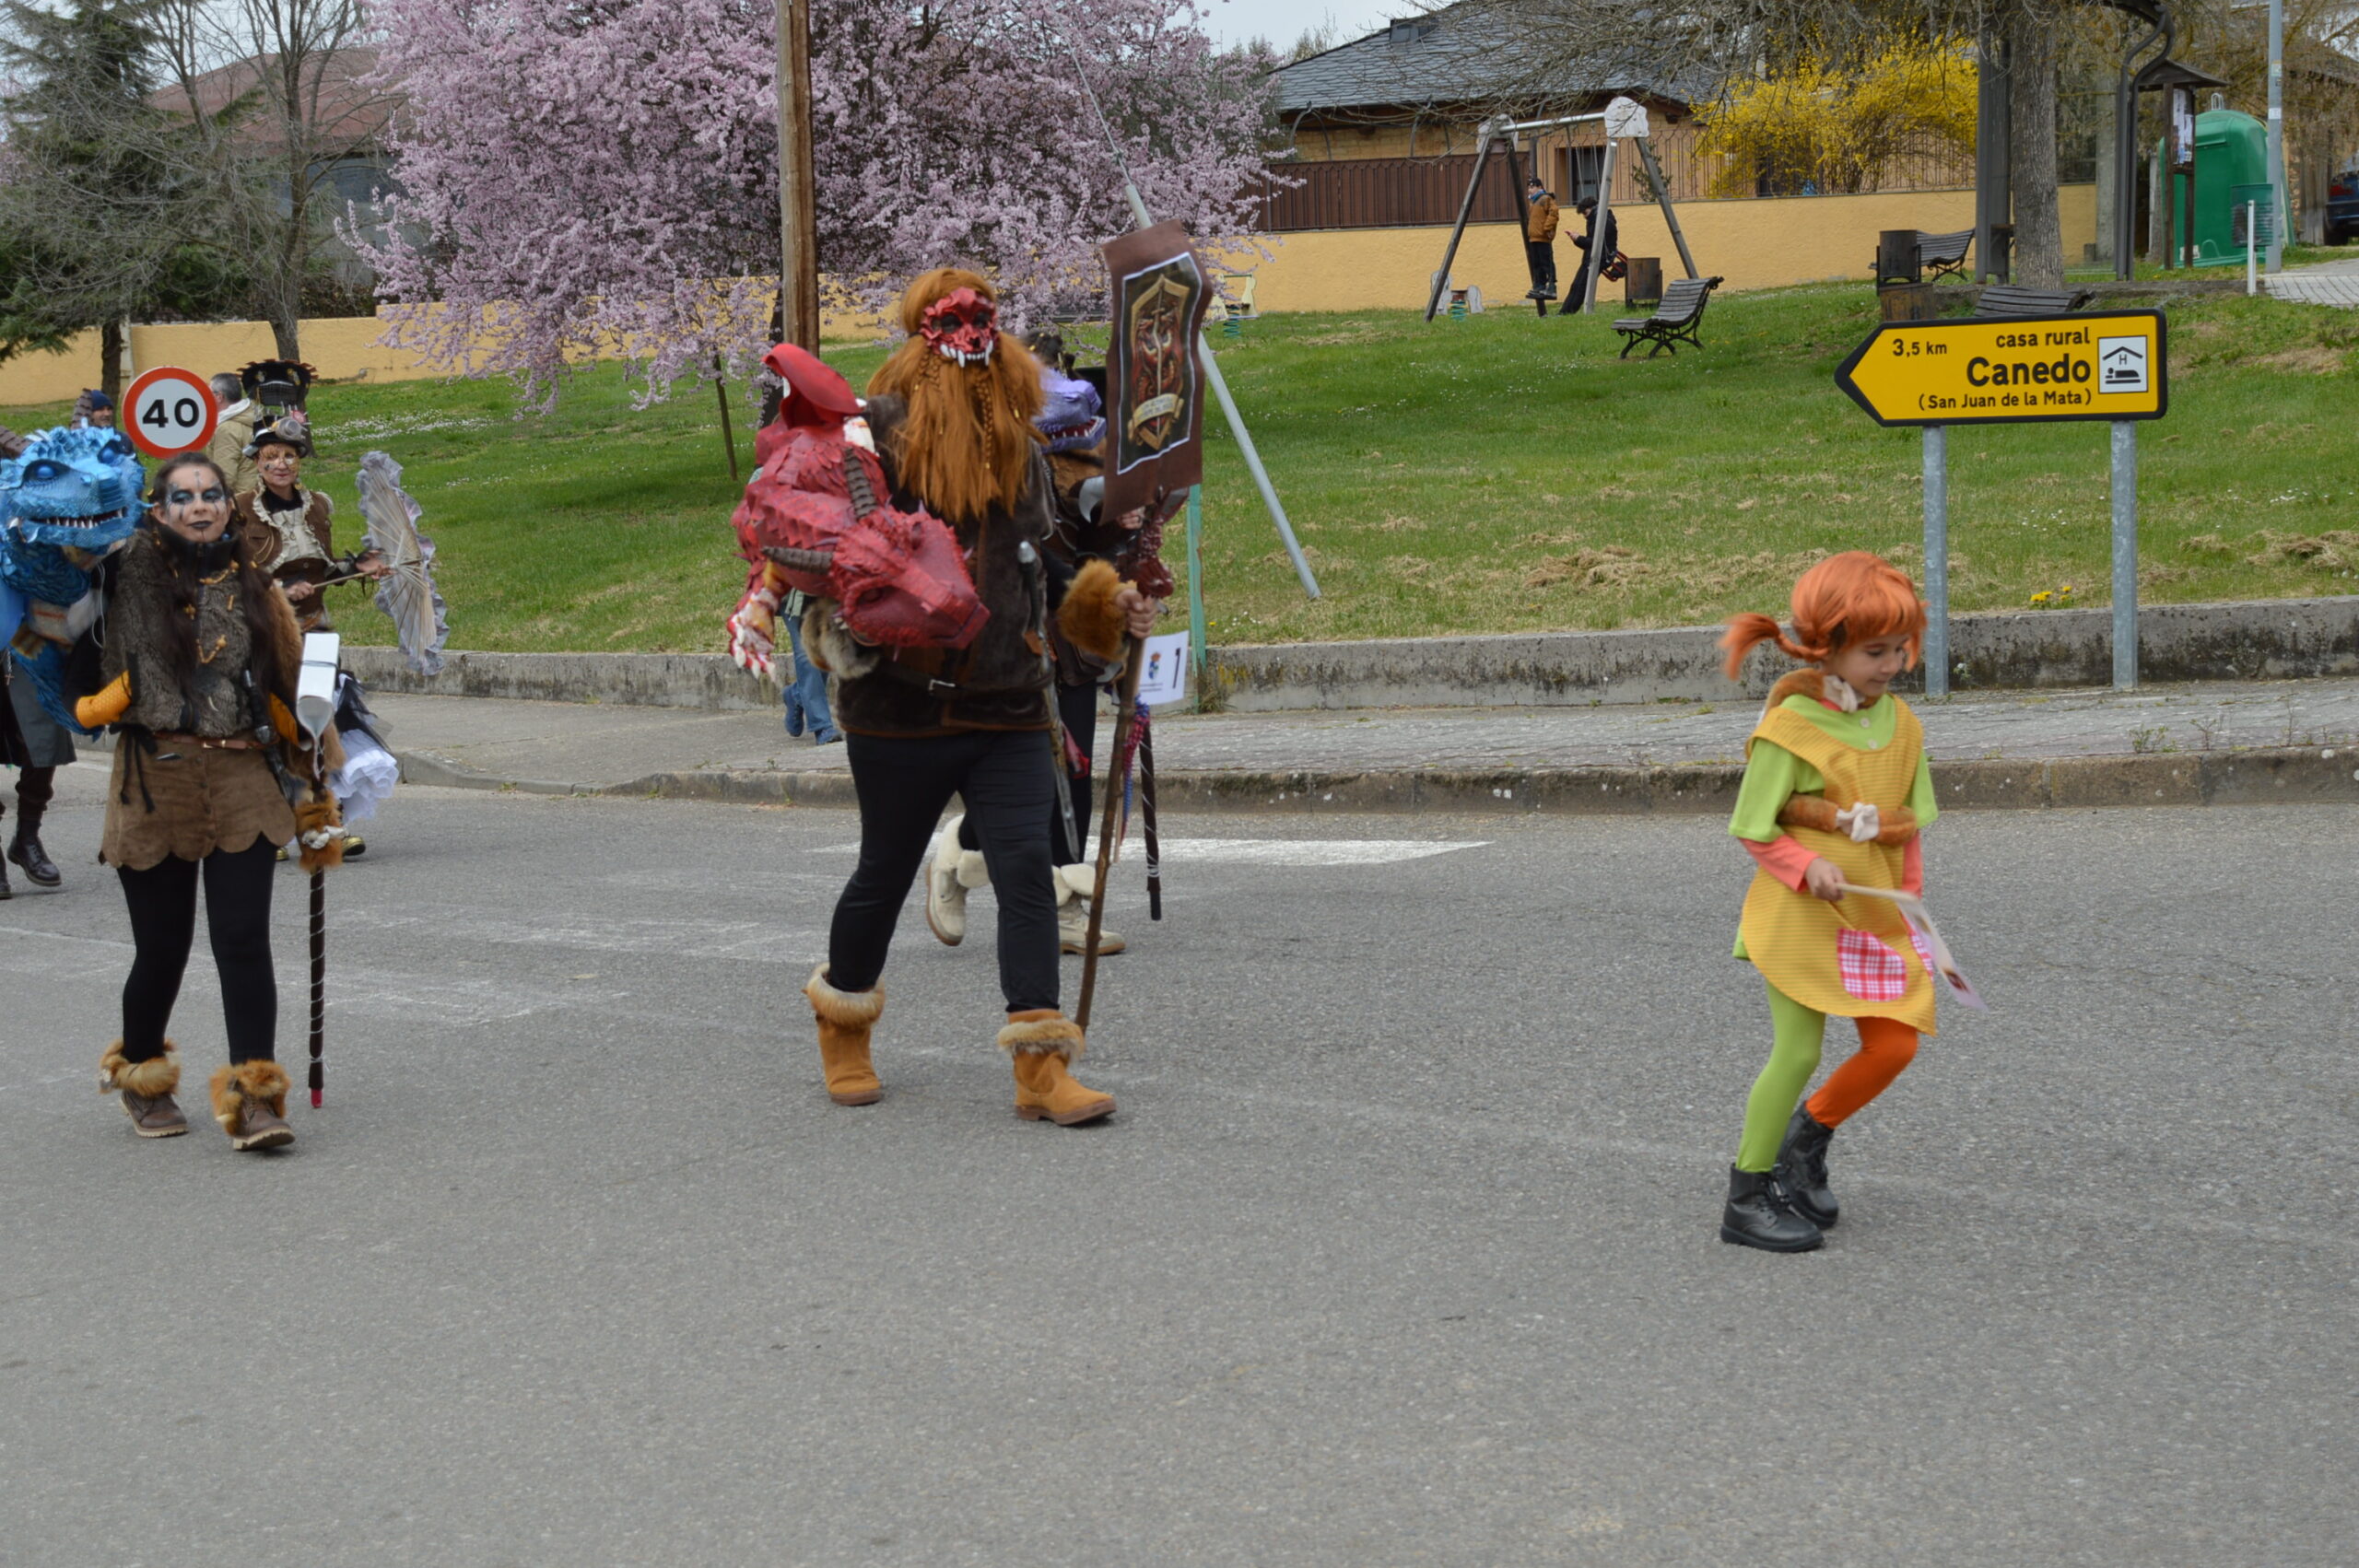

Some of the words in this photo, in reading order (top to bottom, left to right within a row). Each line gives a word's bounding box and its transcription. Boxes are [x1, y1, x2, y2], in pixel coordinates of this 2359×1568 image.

[1892, 338, 1920, 357] 3,5
[1926, 341, 1947, 355] km
[1996, 333, 2038, 348] casa
[2045, 326, 2091, 345] rural
[1966, 353, 2091, 387] Canedo
[2118, 354, 2128, 365] H
[1919, 393, 1956, 411] (San
[1961, 393, 1996, 408] Juan
[2001, 392, 2020, 406] de
[2025, 392, 2037, 405] la
[2044, 388, 2092, 405] Mata)
[142, 397, 200, 428] 40
